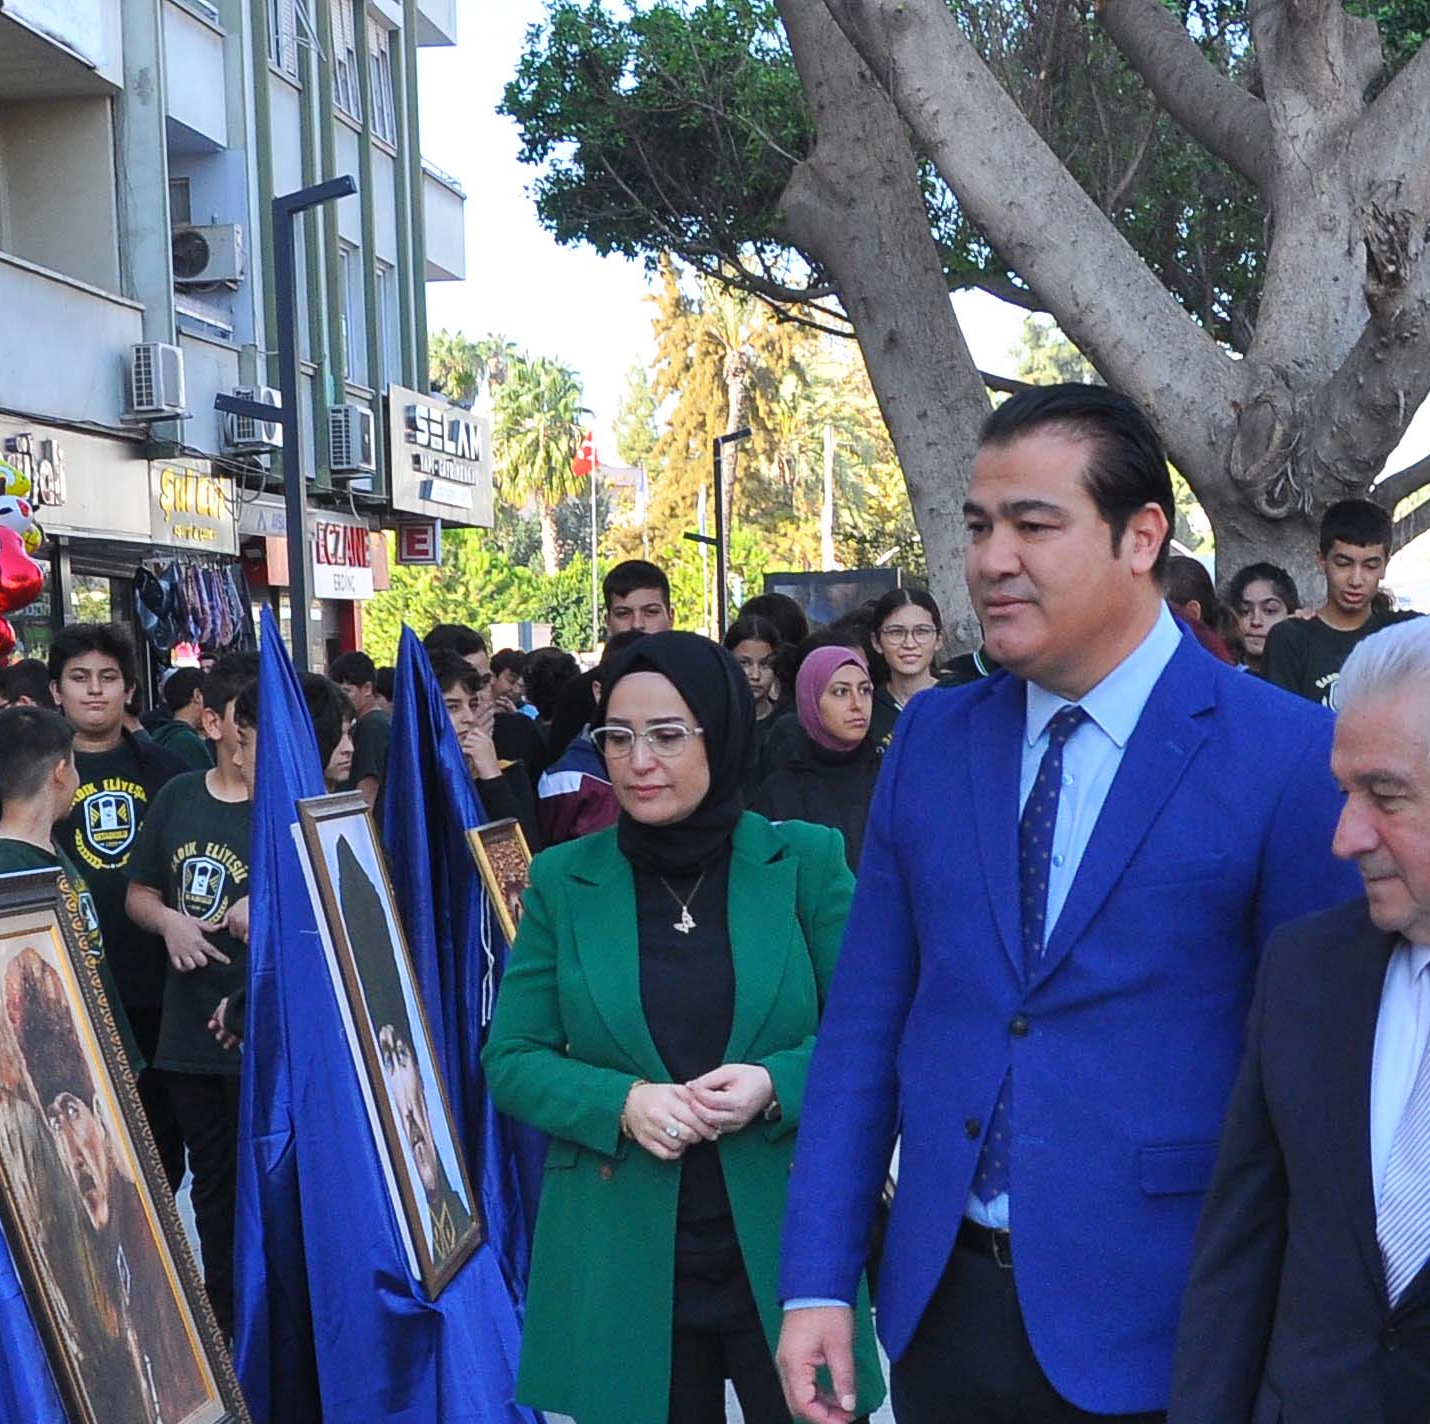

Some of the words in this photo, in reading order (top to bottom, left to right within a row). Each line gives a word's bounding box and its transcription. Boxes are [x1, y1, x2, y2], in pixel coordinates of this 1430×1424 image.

[407, 404, 483, 461] SELAM
[316, 521, 370, 568] ECZANE
[204, 842, 249, 885] ELİYEŞİL
